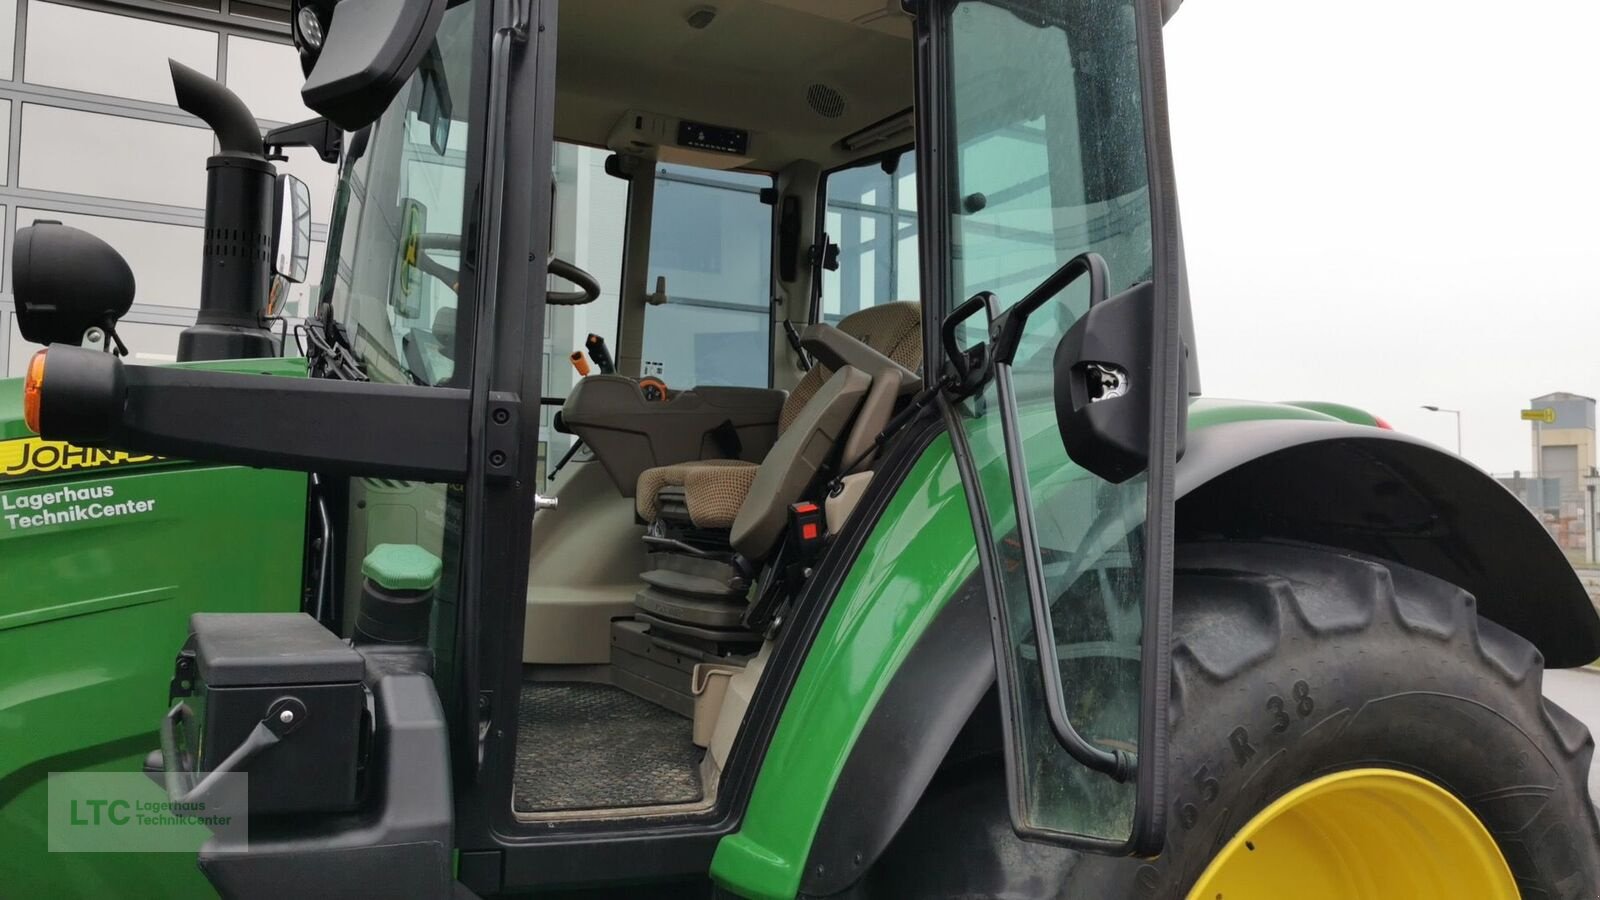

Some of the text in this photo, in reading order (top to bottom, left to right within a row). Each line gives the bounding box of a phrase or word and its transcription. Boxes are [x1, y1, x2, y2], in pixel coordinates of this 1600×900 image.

[6, 443, 117, 472] JOHN
[2, 485, 114, 510] Lagerhaus
[4, 499, 155, 530] TechnikCenter
[1227, 726, 1257, 768] R
[1265, 679, 1314, 733] 38
